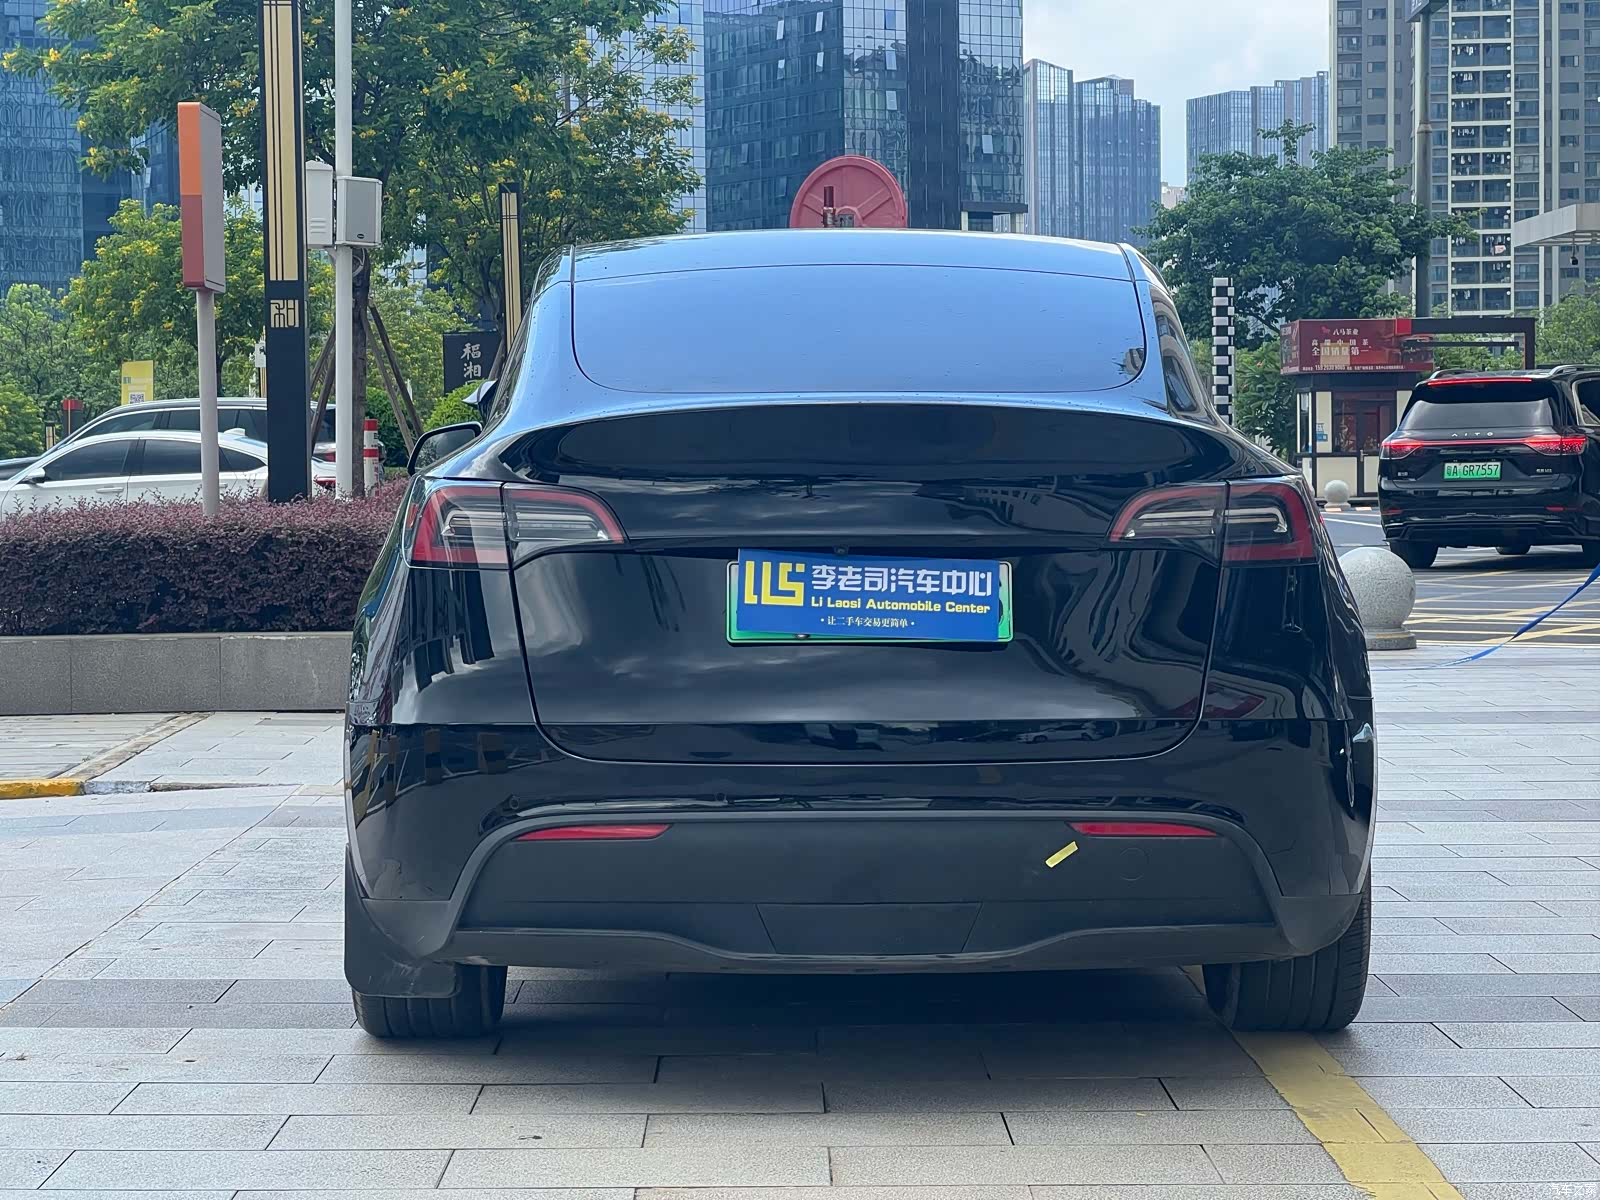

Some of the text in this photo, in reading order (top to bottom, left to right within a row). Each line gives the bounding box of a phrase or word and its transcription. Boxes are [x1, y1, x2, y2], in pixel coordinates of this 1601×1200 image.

[1462, 464, 1499, 476] GR7557
[811, 564, 992, 597] 李老司汽车中心
[811, 596, 991, 614] Li Laosi Automobile Center
[827, 615, 909, 628] 让二手车交易更简单
